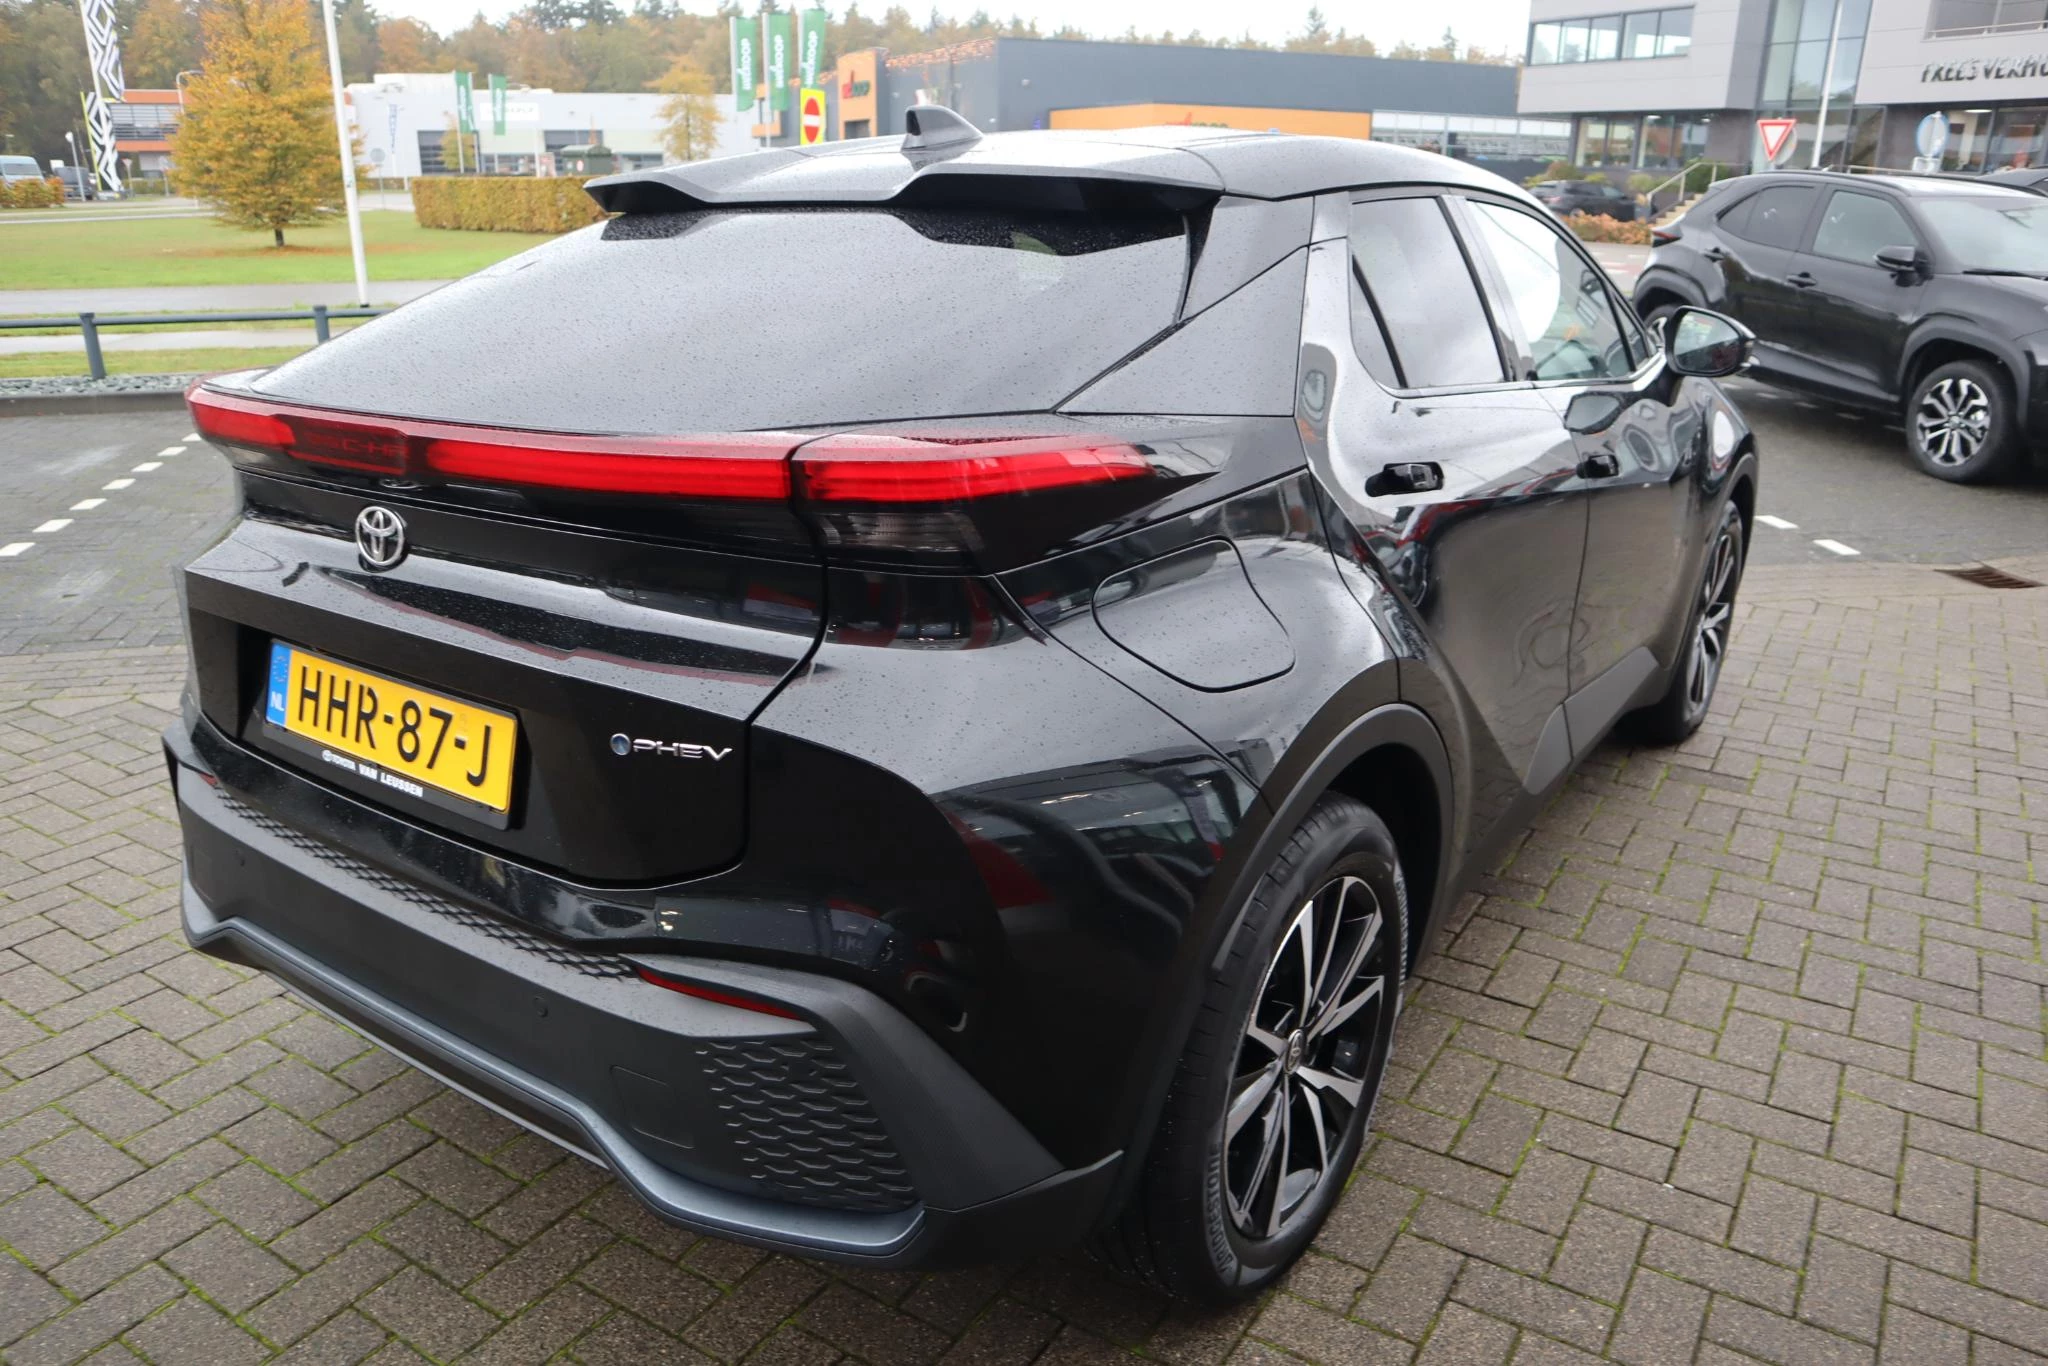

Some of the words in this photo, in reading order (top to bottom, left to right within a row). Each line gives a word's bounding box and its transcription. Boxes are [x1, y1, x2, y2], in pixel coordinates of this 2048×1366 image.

[270, 691, 284, 712] NL
[298, 665, 491, 787] HHR-87-J
[633, 738, 732, 760] PHEV
[358, 763, 378, 780] VAN
